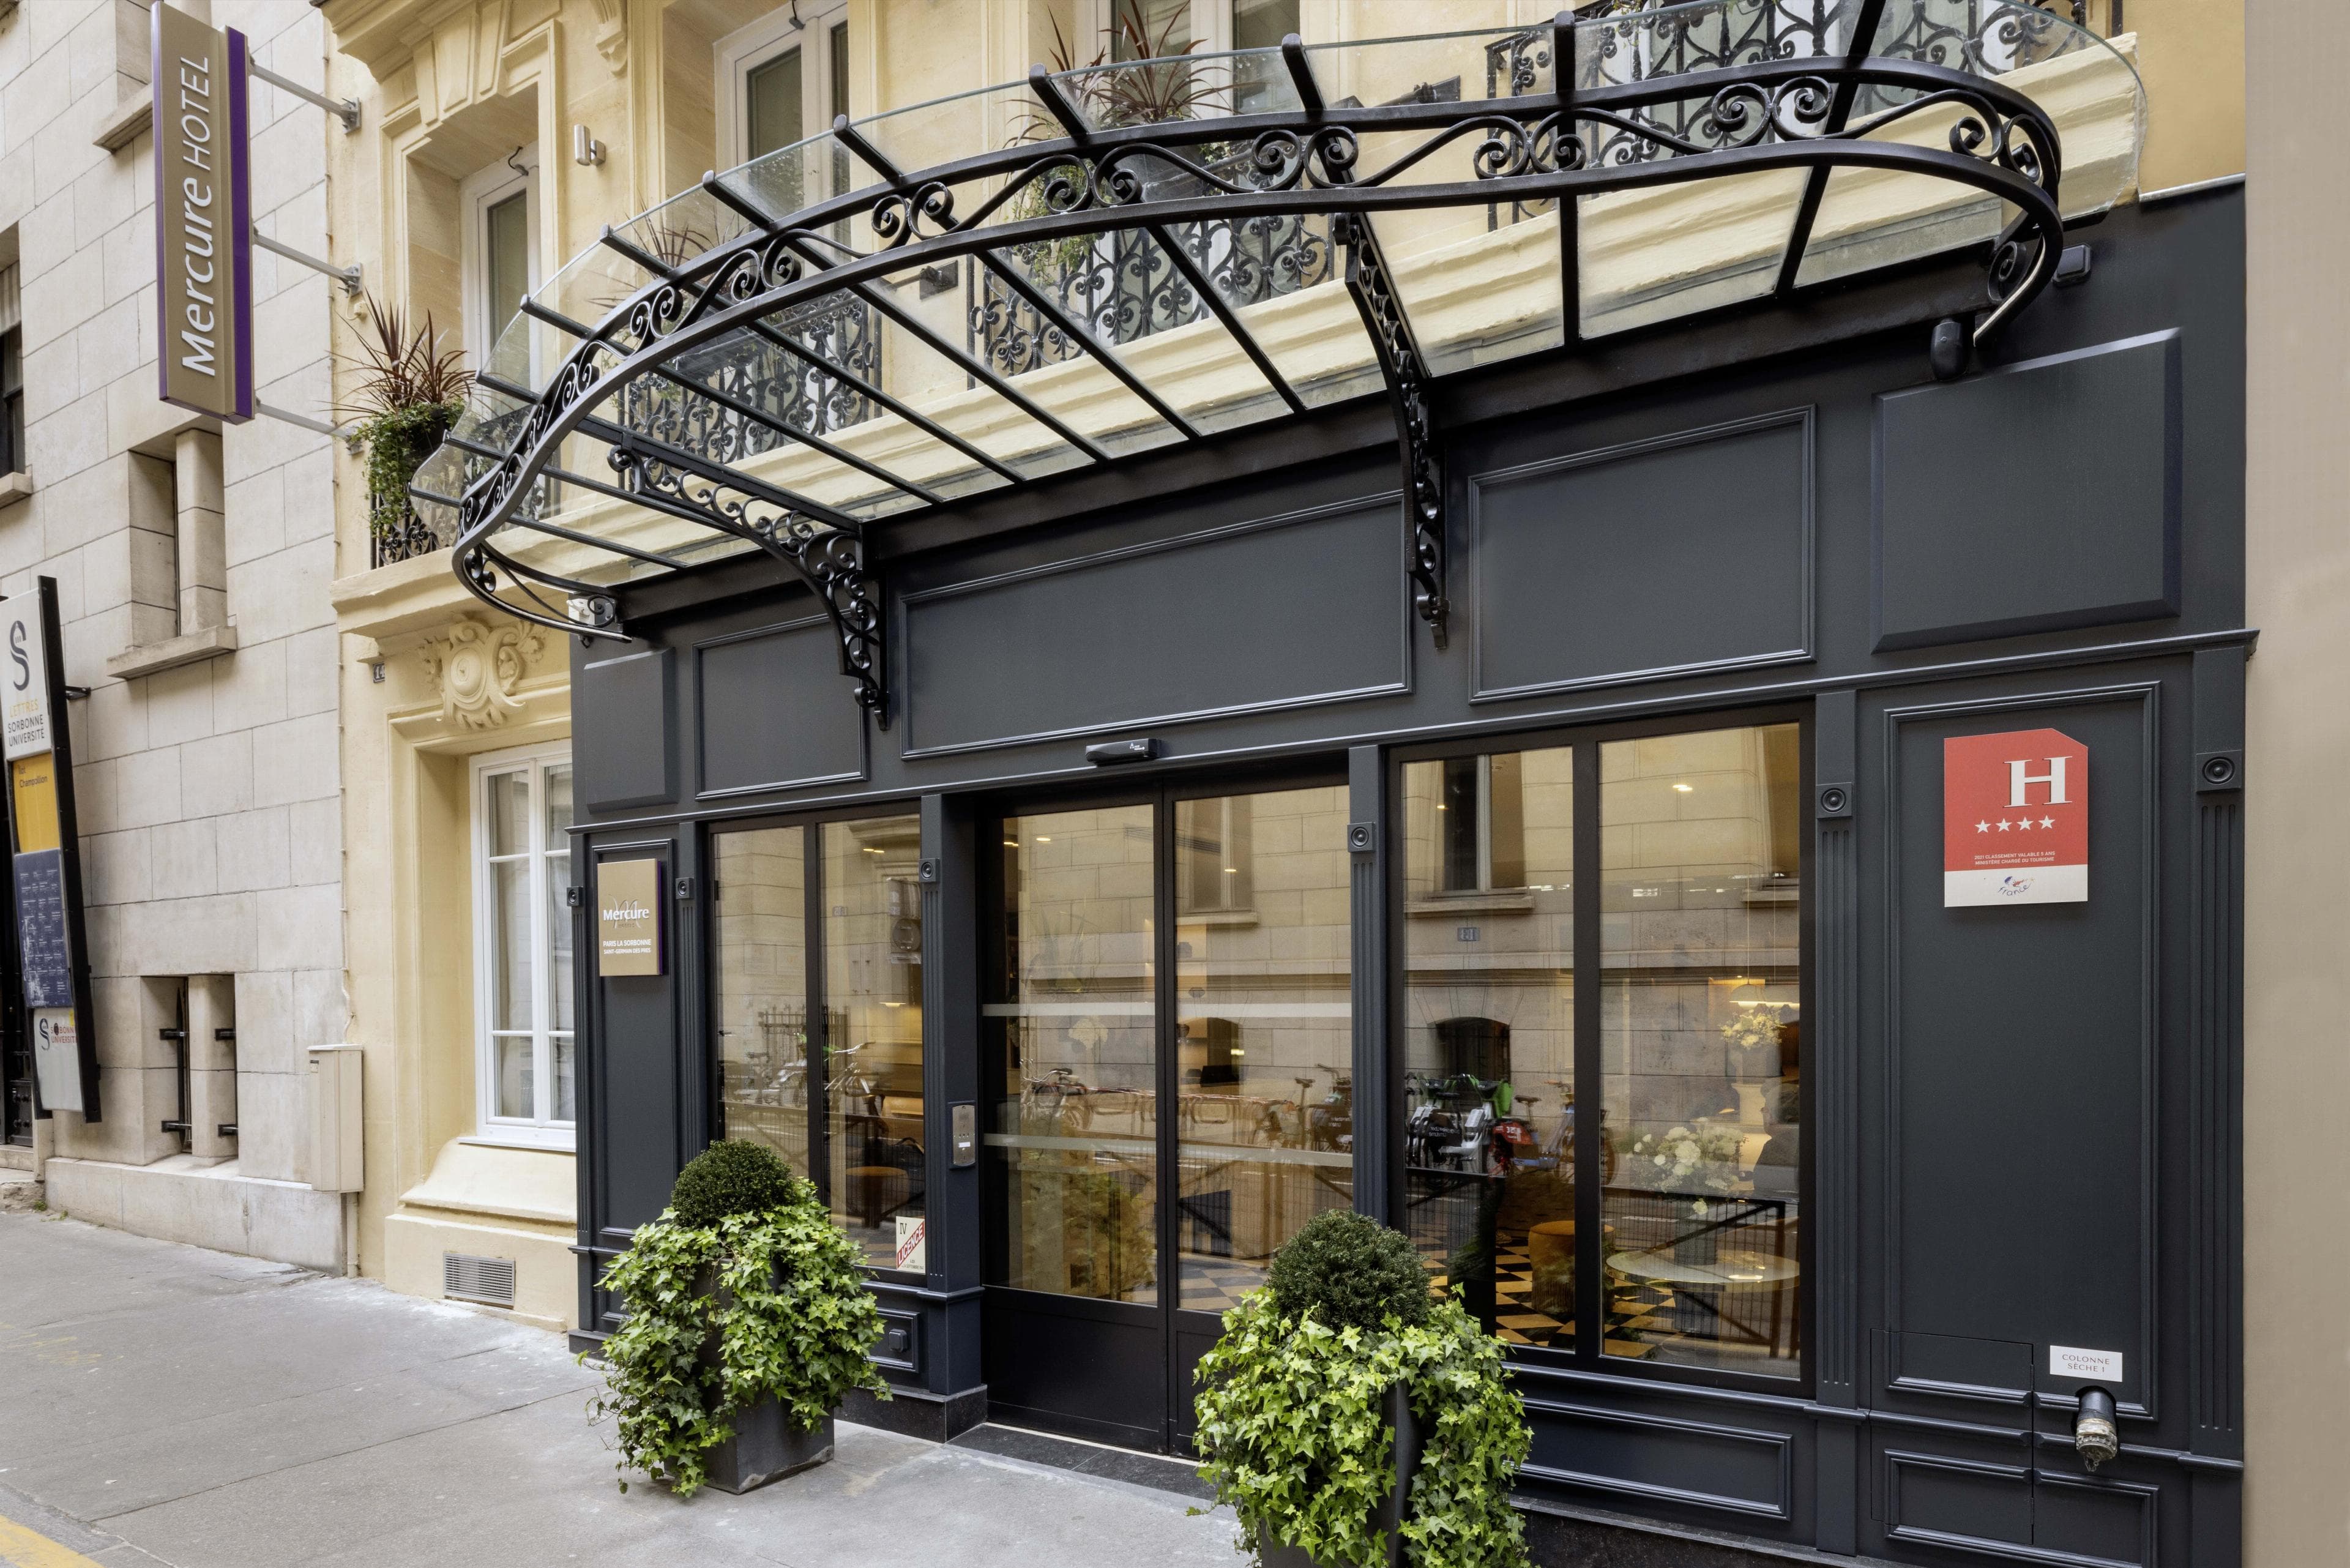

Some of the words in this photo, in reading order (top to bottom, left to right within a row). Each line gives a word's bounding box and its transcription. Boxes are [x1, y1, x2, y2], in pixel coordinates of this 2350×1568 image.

[181, 56, 211, 171] HOTEL
[181, 177, 215, 376] Mercure
[9, 700, 39, 717] LETTRES
[8, 714, 43, 733] SORBONNE
[9, 726, 45, 747] UNIVERSITÉ
[2002, 756, 2073, 808] H
[603, 909, 649, 921] Mercure
[900, 1223, 907, 1234] IV
[898, 1223, 923, 1264] LICENCE
[2062, 1354, 2110, 1365] COLONNE
[2067, 1362, 2098, 1372] SÈCHE
